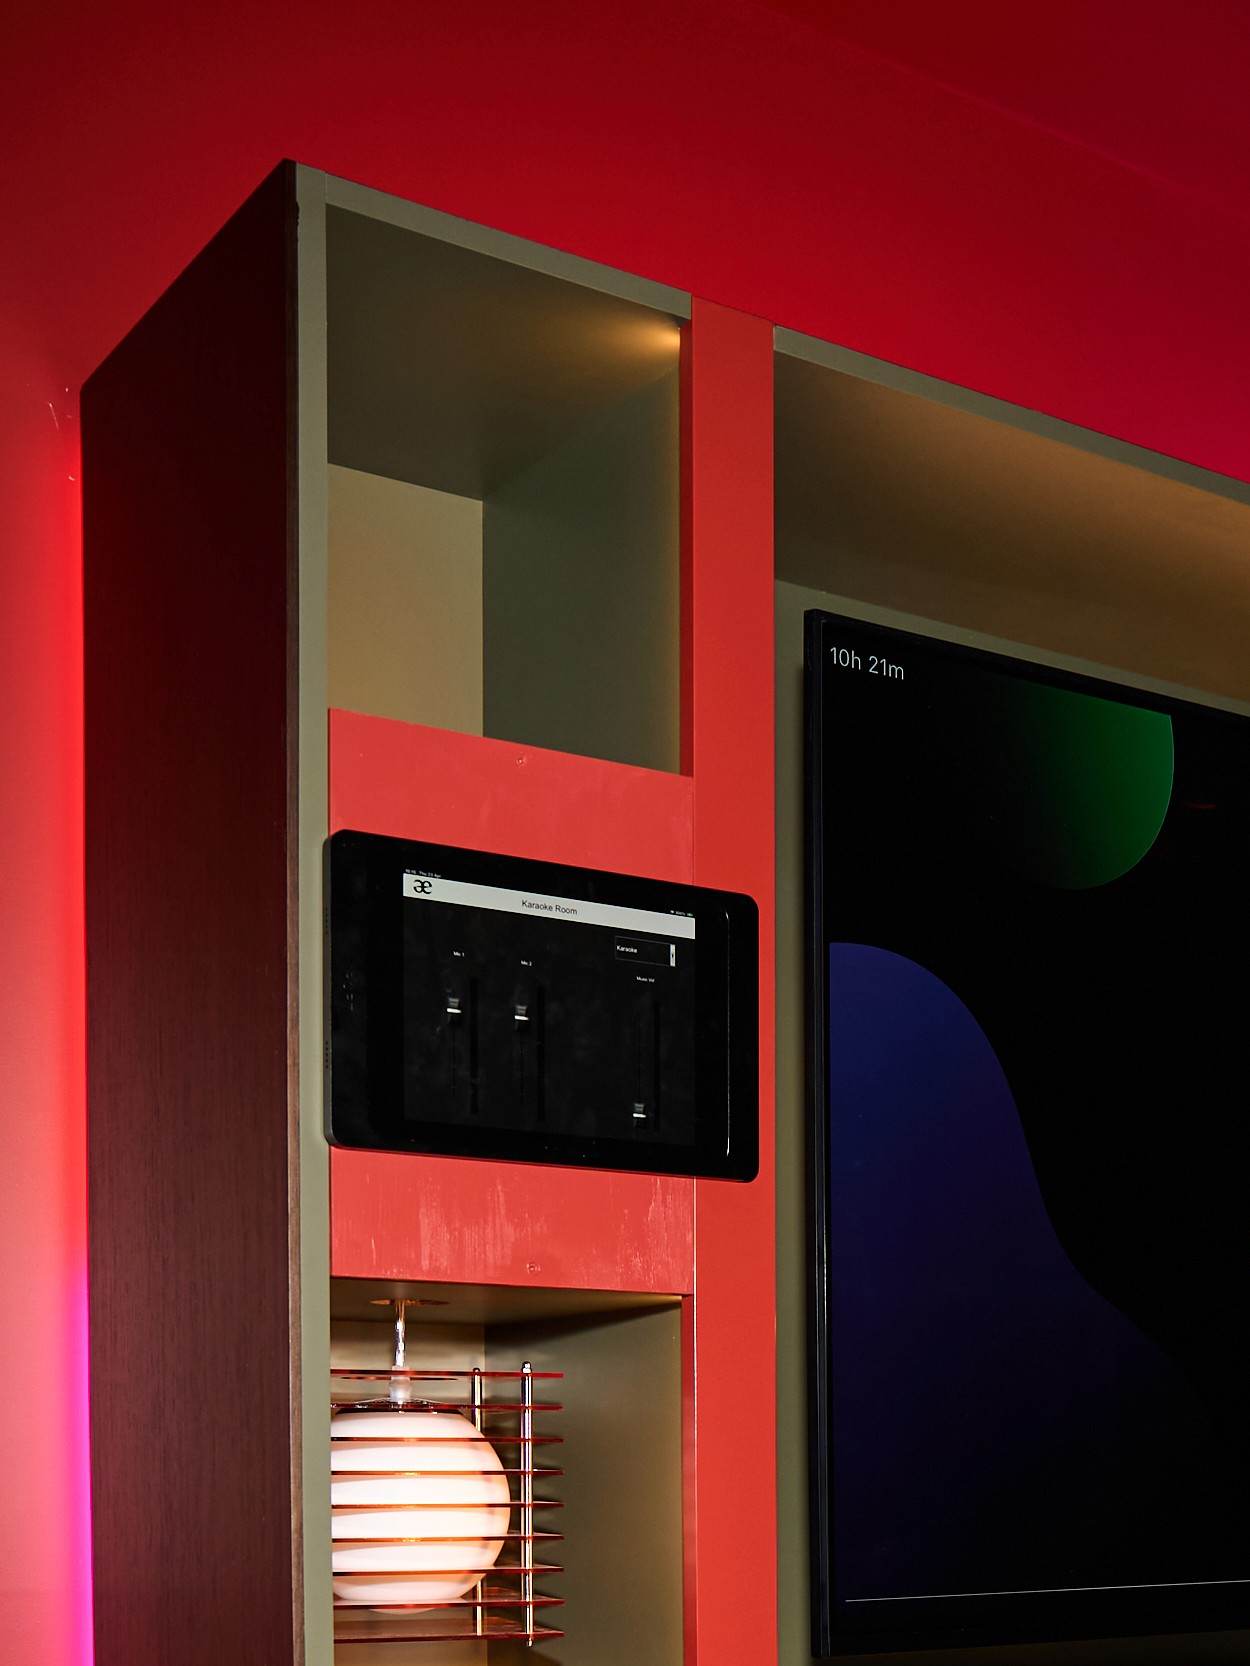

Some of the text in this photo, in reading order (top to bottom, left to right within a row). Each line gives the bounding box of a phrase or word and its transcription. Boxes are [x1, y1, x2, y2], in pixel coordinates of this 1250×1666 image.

[830, 647, 904, 680] 10h 21m
[521, 899, 578, 915] Karaoke Room
[616, 945, 638, 954] Karaoke
